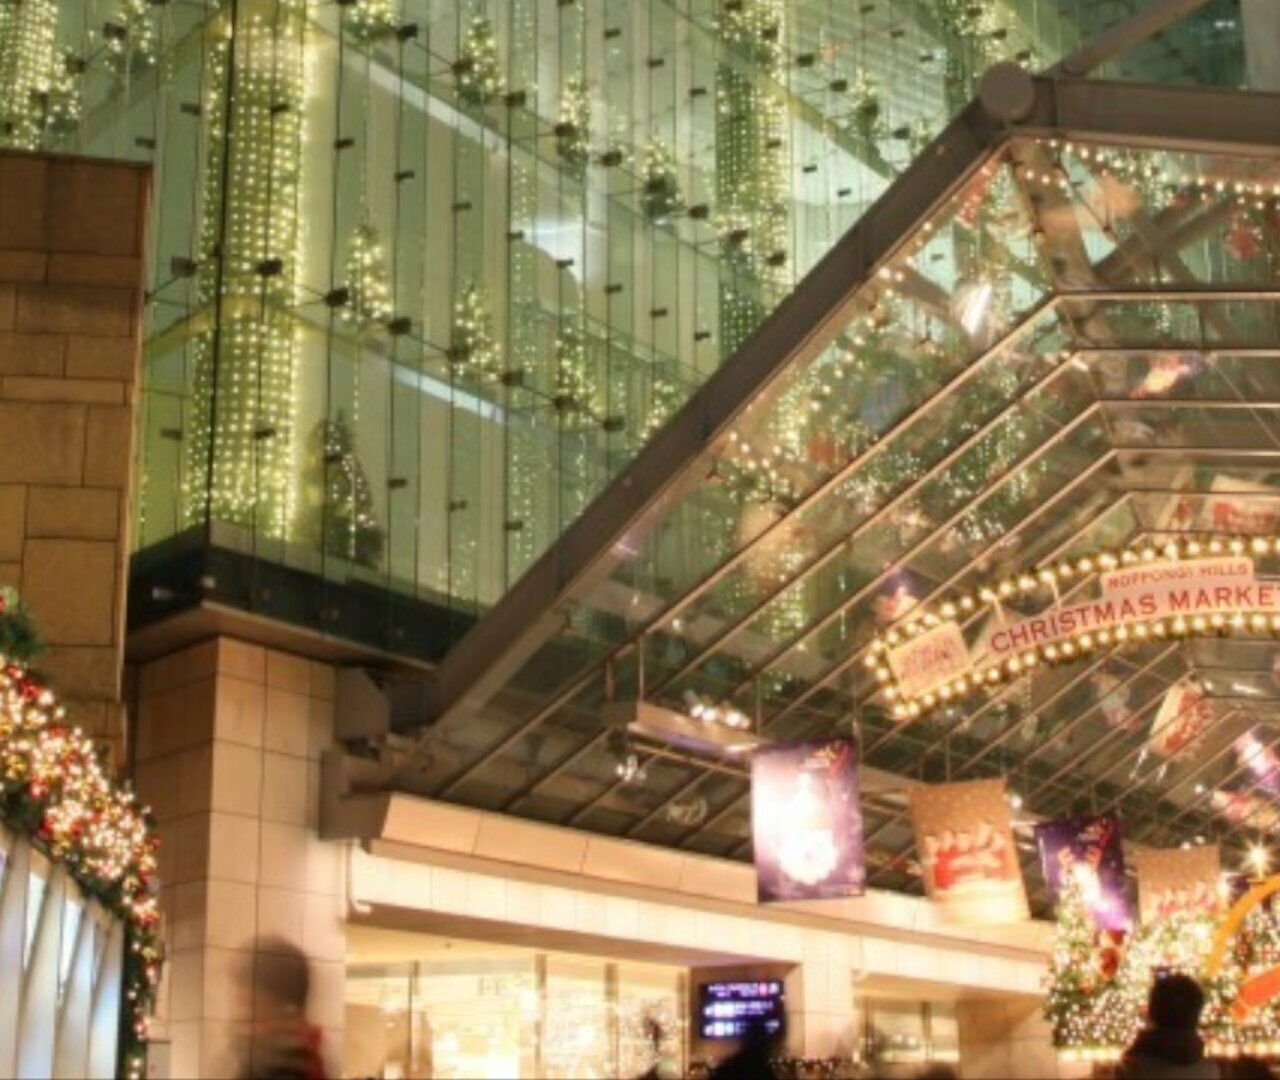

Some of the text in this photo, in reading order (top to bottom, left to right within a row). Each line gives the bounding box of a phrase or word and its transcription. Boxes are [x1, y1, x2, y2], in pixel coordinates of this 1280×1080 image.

[1108, 561, 1249, 589] ROPPONGI HILLS
[990, 593, 1157, 655] CHRISTMAS
